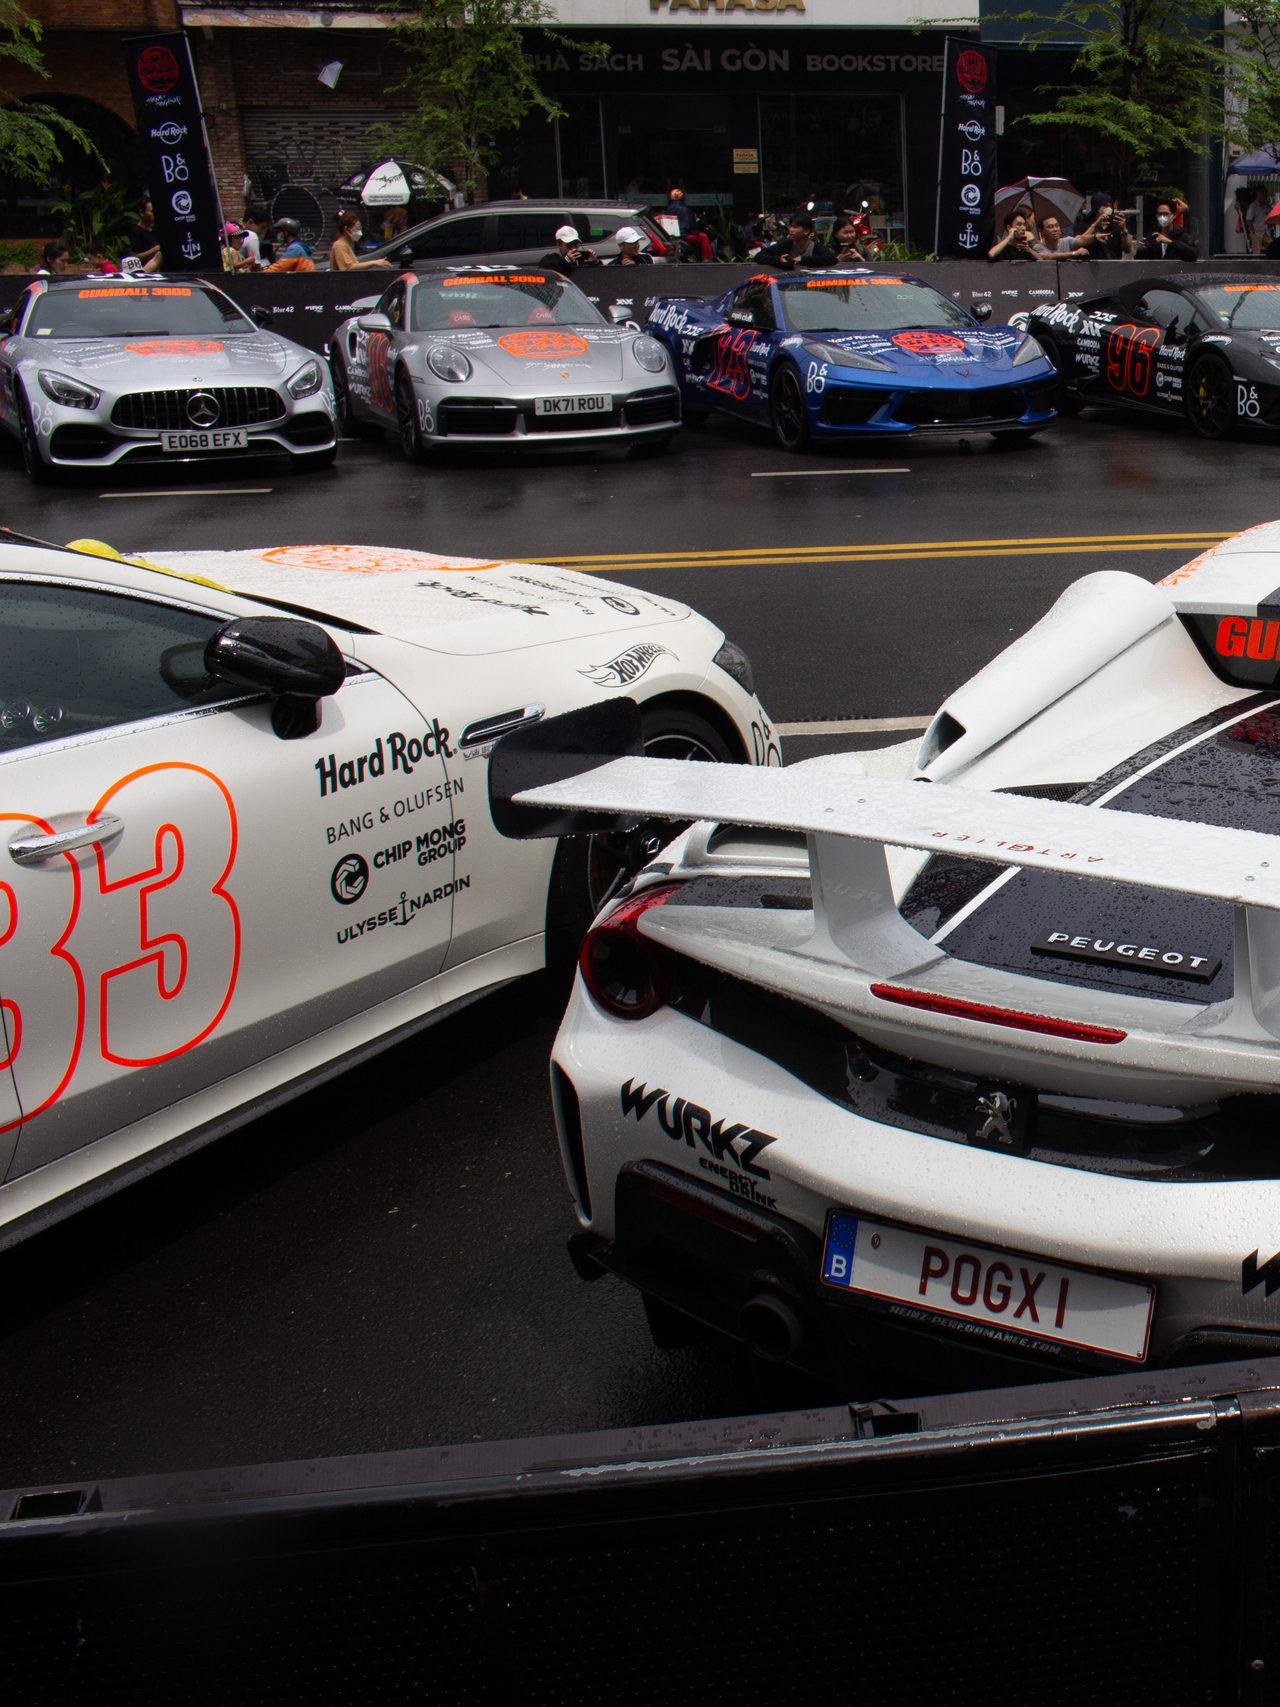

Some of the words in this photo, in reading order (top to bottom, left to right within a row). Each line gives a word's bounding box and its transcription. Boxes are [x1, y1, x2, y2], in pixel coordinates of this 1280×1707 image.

[662, 43, 711, 72] SÀI
[721, 43, 790, 72] GÒN
[807, 54, 944, 72] BOOKSTORE
[958, 123, 973, 133] Hard
[78, 288, 150, 299] GUMBALL
[151, 287, 192, 296] 3000
[443, 277, 507, 286] GUMBALL
[509, 275, 546, 284] 3000
[806, 279, 869, 288] GUMBALL
[664, 304, 689, 335] Rock
[1049, 302, 1083, 333] Rock
[1077, 338, 1100, 350] CAMBODIA
[1107, 323, 1160, 396] 96
[1159, 345, 1174, 358] Hard
[1172, 347, 1187, 361] Rock
[1075, 353, 1100, 367] WURKZ
[543, 399, 576, 413] DK71
[579, 396, 605, 410] ROU
[212, 432, 242, 447] EFX
[605, 661, 640, 684] HOT
[635, 643, 667, 672] WHEELS
[314, 738, 384, 797] Hard
[386, 718, 453, 775] Rock
[326, 811, 374, 845] BANG
[379, 806, 392, 823] &
[394, 776, 465, 818] OLUFSEN
[372, 843, 413, 870] CHIP
[416, 818, 466, 852] MONG
[417, 835, 466, 867] GROUP
[336, 907, 398, 945] ULYSSE
[409, 875, 471, 913] NARDIN
[1047, 931, 1209, 970] PEUGEOT
[621, 1077, 779, 1181] WURKZ
[699, 1156, 758, 1190] ENERGY
[728, 1180, 778, 1210] DRINK
[829, 1255, 847, 1279] B
[889, 1305, 1063, 1355] HEINZ-PERFORMANCE.COM
